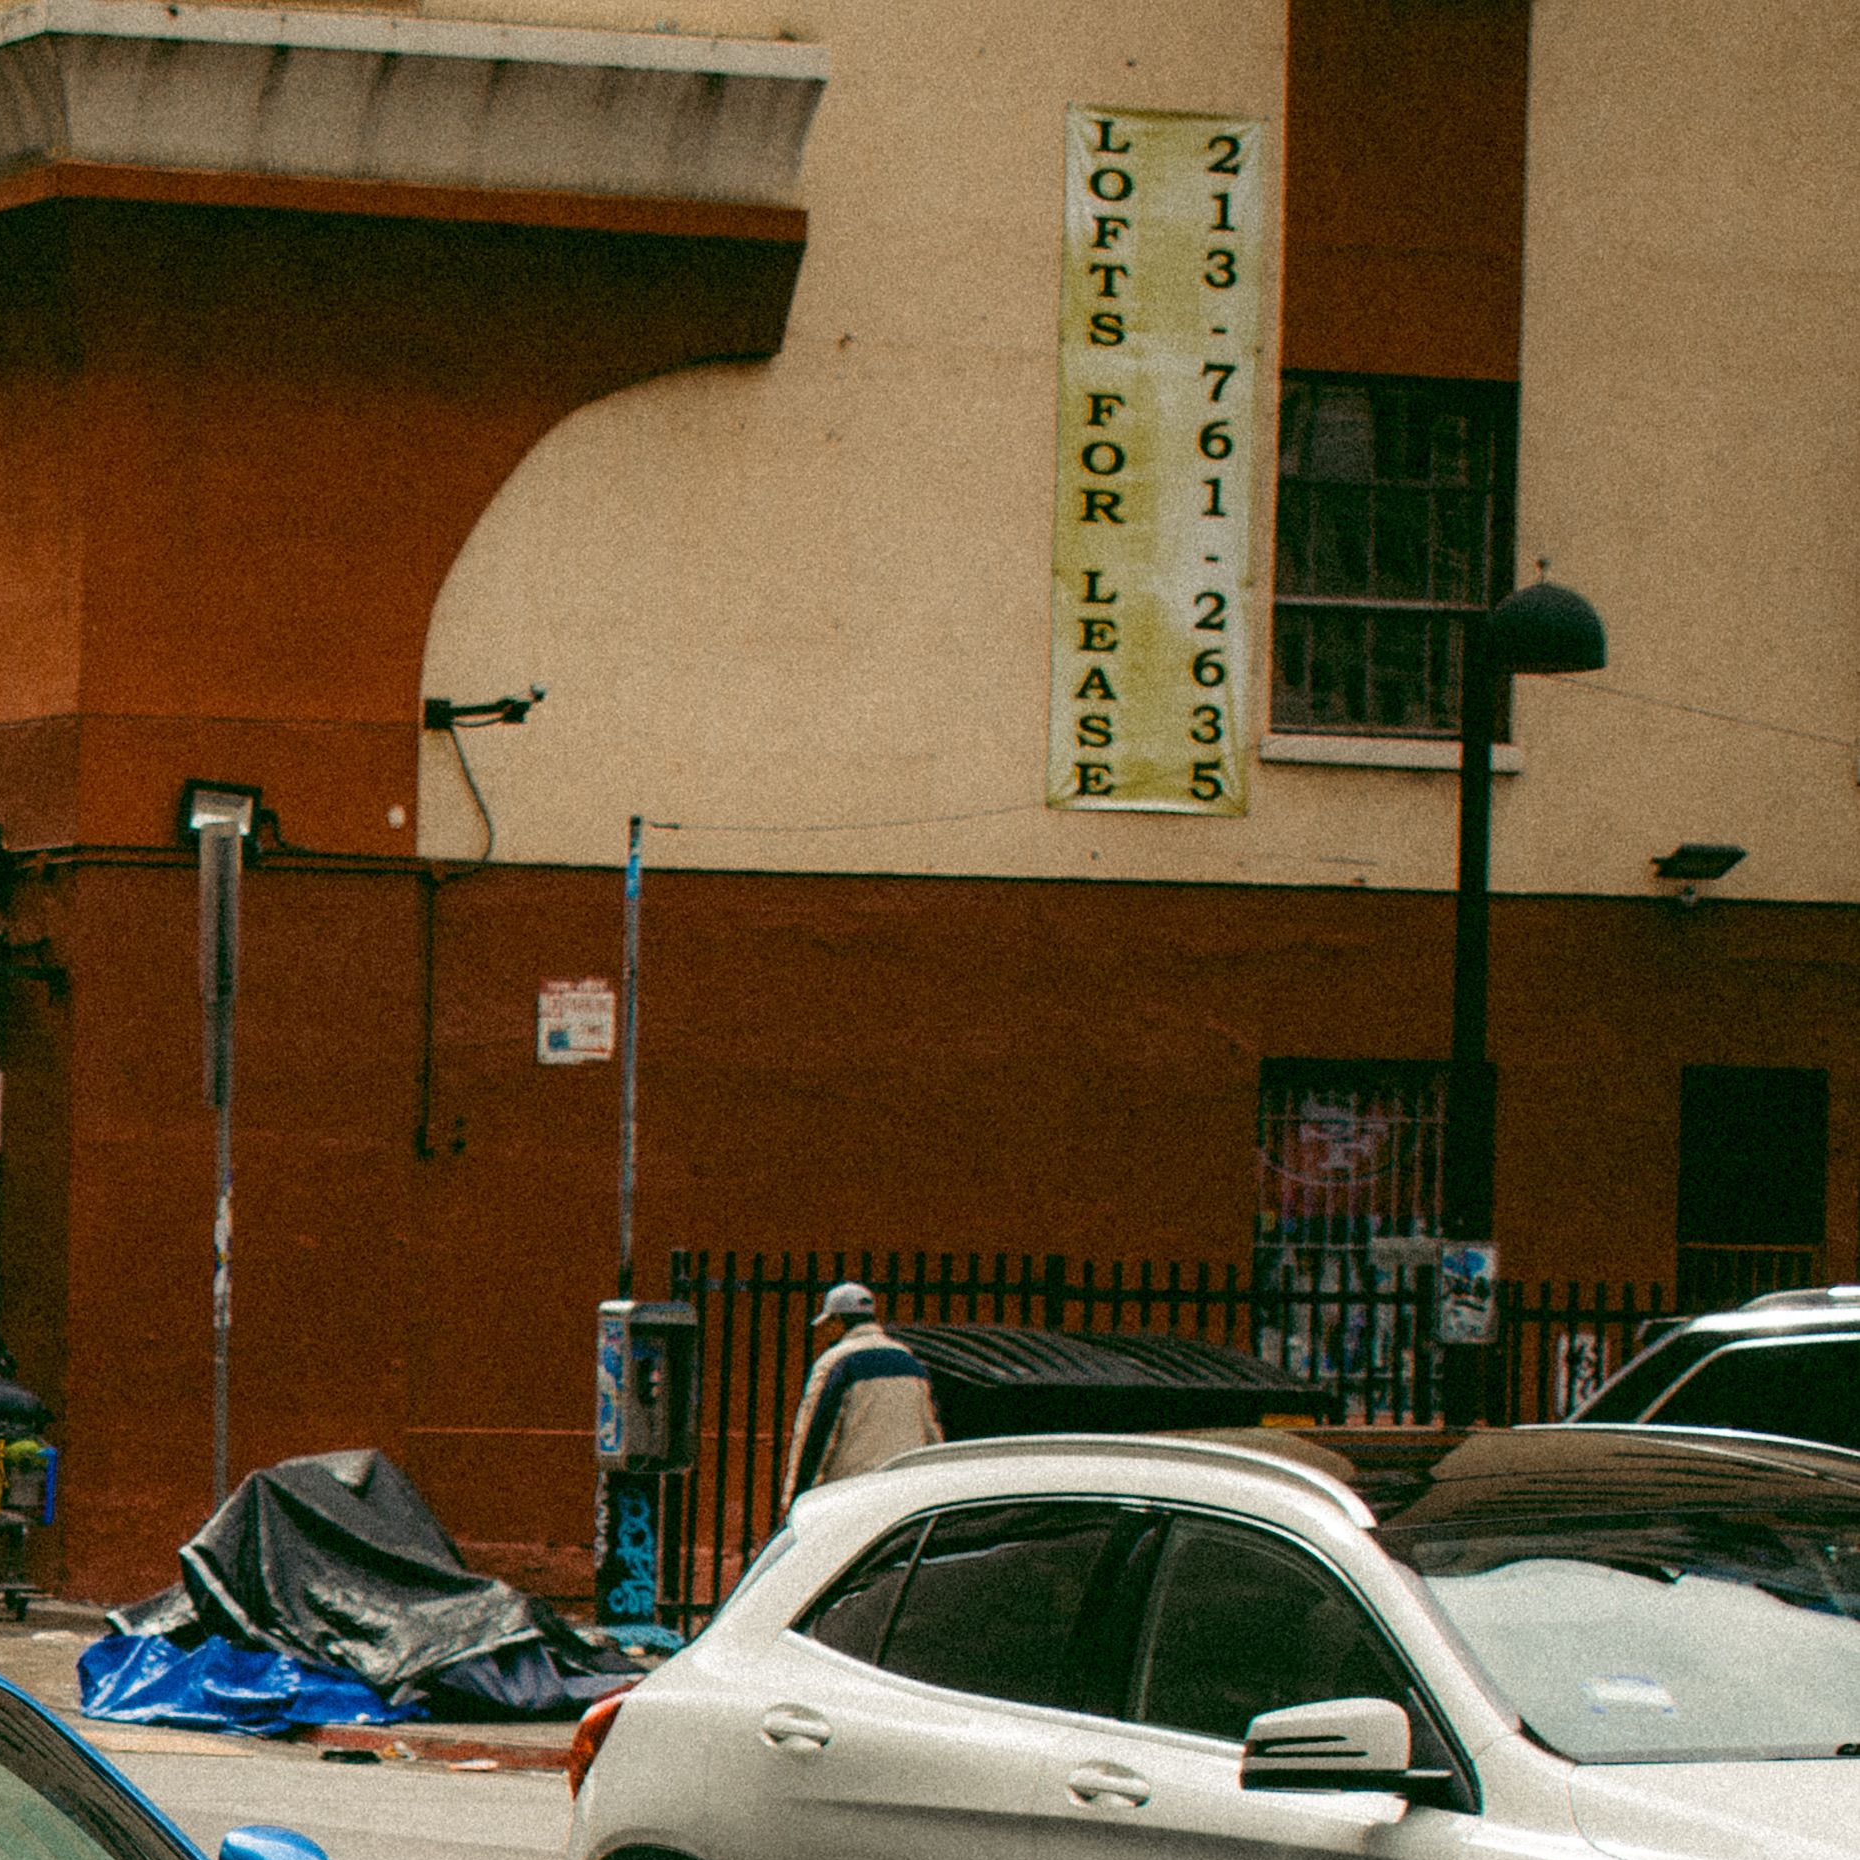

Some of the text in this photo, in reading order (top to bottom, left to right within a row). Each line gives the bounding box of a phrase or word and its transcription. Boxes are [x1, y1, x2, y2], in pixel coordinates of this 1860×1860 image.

[1072, 118, 1135, 800] LOFTS FOR LEASE
[1189, 134, 1243, 804] 213-761-2635
